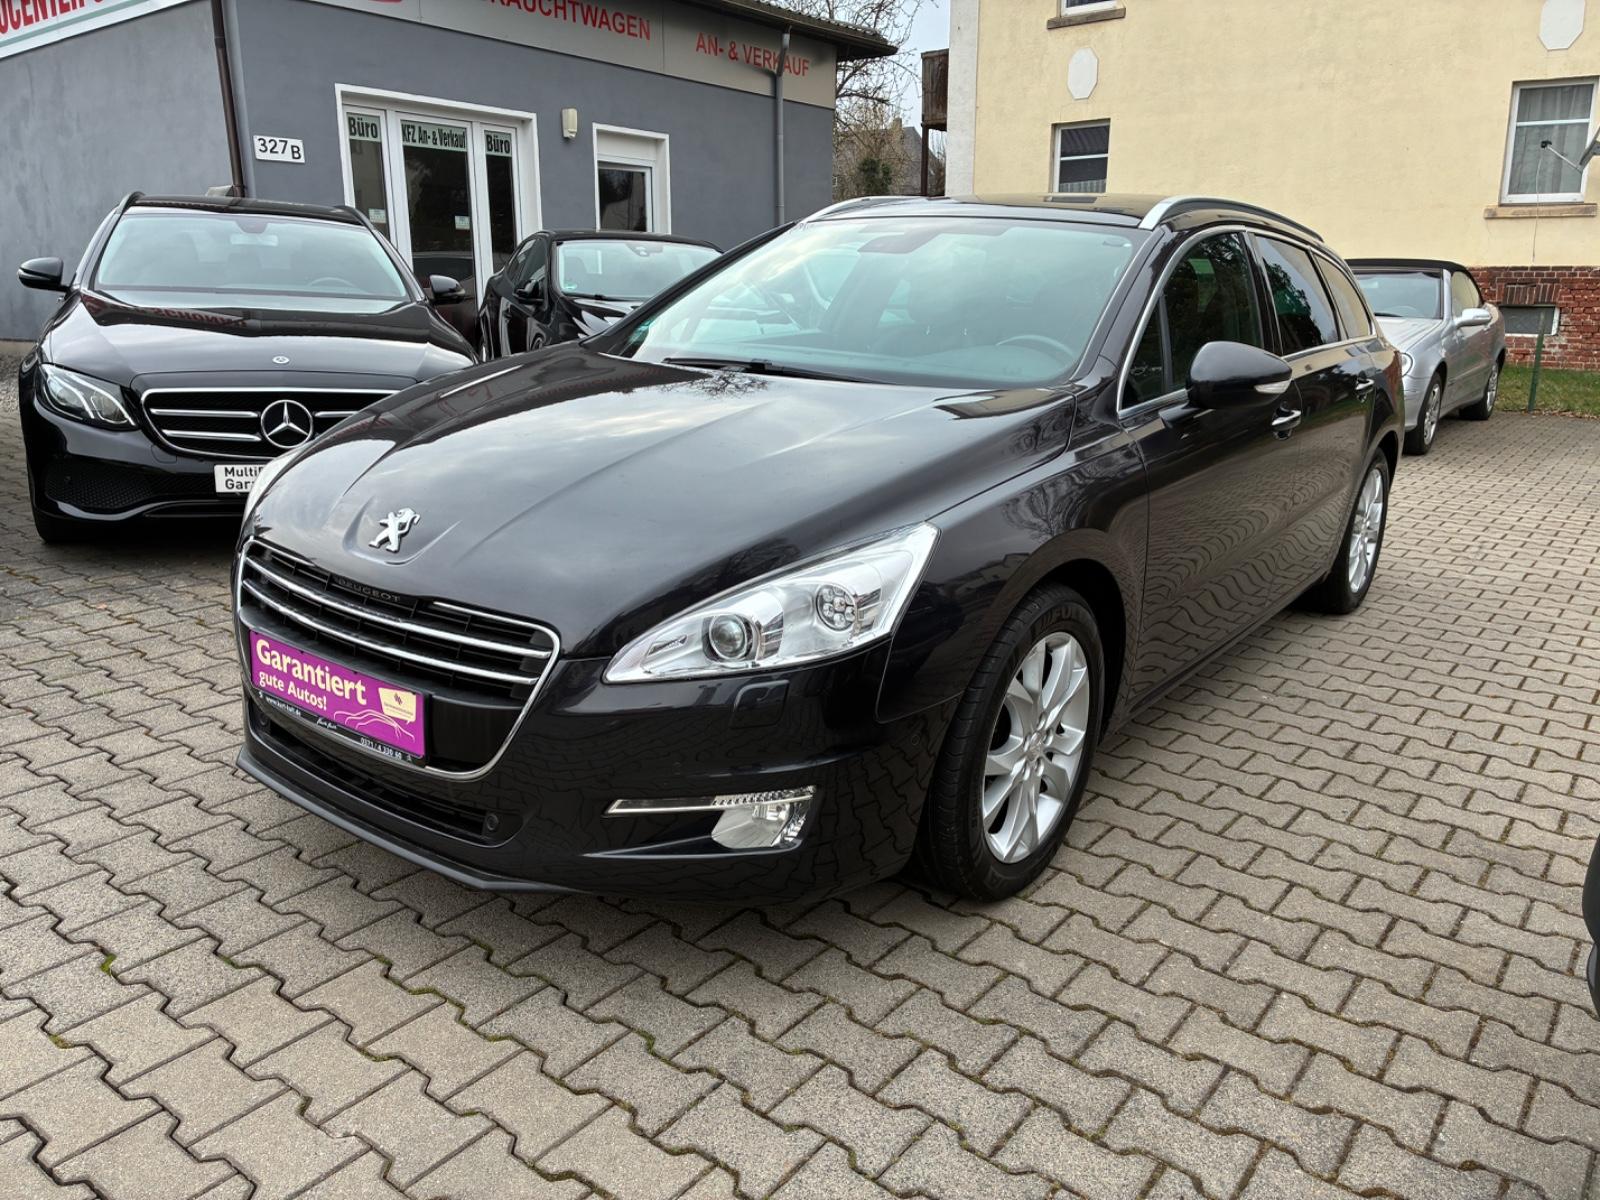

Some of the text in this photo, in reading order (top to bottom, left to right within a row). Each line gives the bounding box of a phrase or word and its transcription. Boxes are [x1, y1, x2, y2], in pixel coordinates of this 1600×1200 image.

[491, 0, 651, 41] UCHTWAGEN
[696, 32, 724, 56] AN-
[728, 41, 738, 61] &
[347, 116, 379, 138] Büro
[402, 123, 467, 149] KFZ An- & Verkauf
[486, 134, 511, 154] Büro
[225, 478, 254, 490] Gar
[256, 638, 367, 705] Garantiert
[259, 671, 285, 692] gute
[288, 684, 327, 711] Autos!
